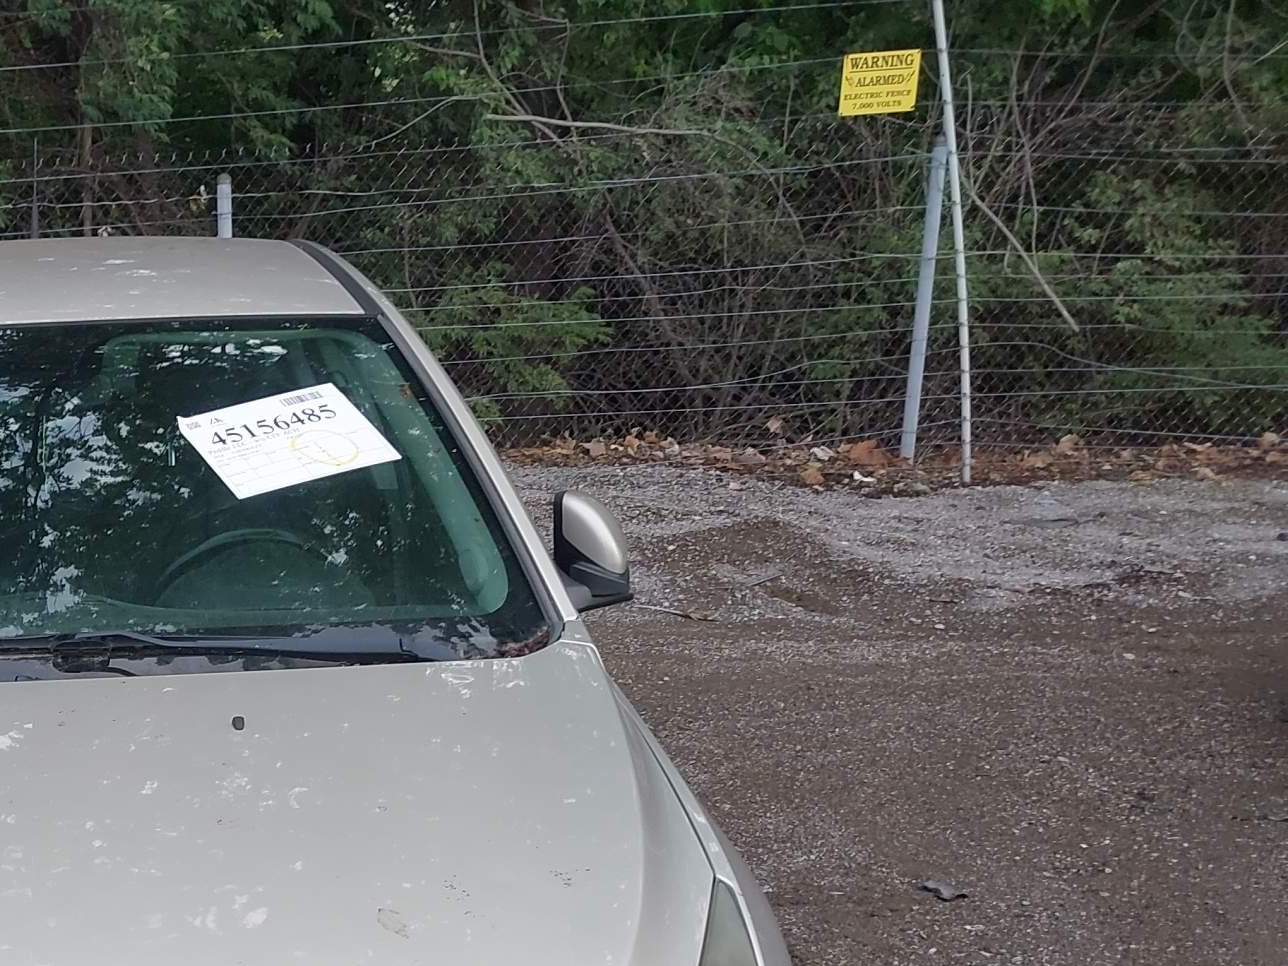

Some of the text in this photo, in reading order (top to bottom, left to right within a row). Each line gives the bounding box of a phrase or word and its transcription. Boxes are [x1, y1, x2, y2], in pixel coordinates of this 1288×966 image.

[850, 54, 914, 70] WARNING
[855, 75, 905, 87] ALARMED
[843, 89, 912, 101] ELECTRIC FENCE
[211, 404, 337, 446] 45156485
